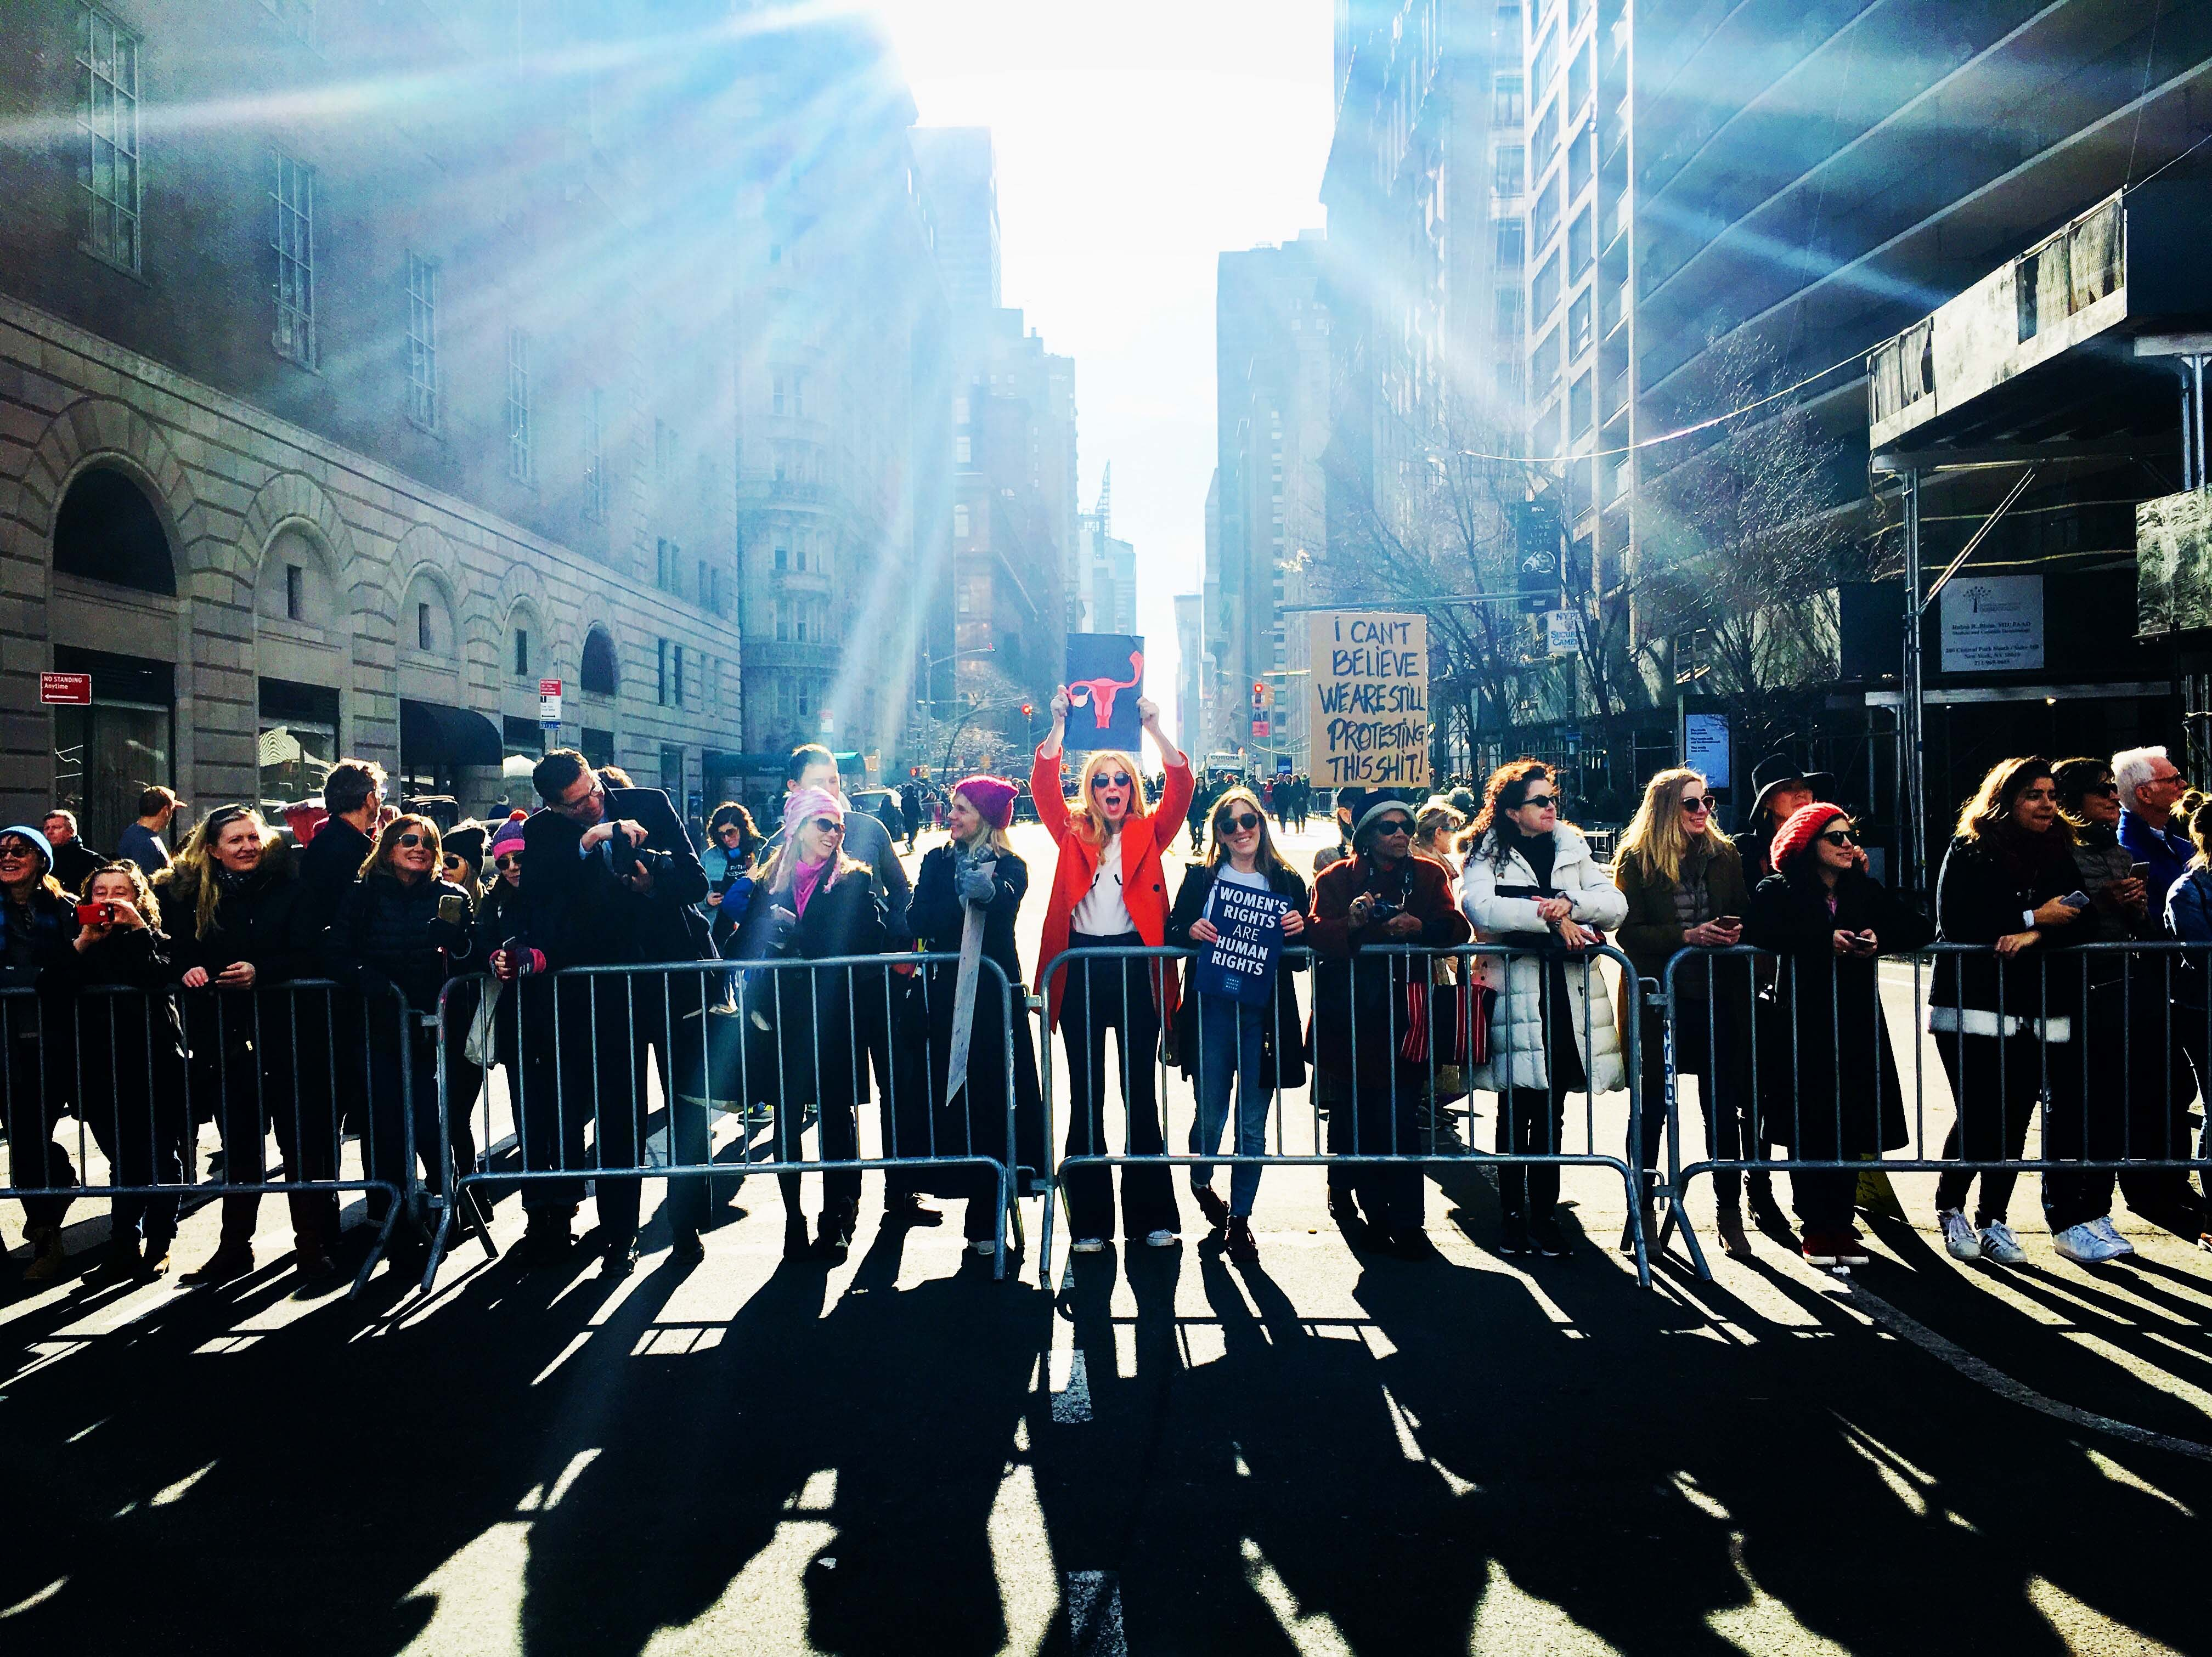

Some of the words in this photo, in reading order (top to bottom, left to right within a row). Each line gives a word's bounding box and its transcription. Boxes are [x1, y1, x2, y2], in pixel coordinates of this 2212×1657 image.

[1351, 620, 1411, 646] CAN'T
[1327, 717, 1425, 754] PROTESTING
[1220, 886, 1288, 915] WOMEN'S
[1223, 904, 1277, 929] RIGHTS
[1232, 924, 1260, 942] ARE
[1215, 935, 1268, 961] HUMAN
[1211, 951, 1265, 976] RIGHTS
